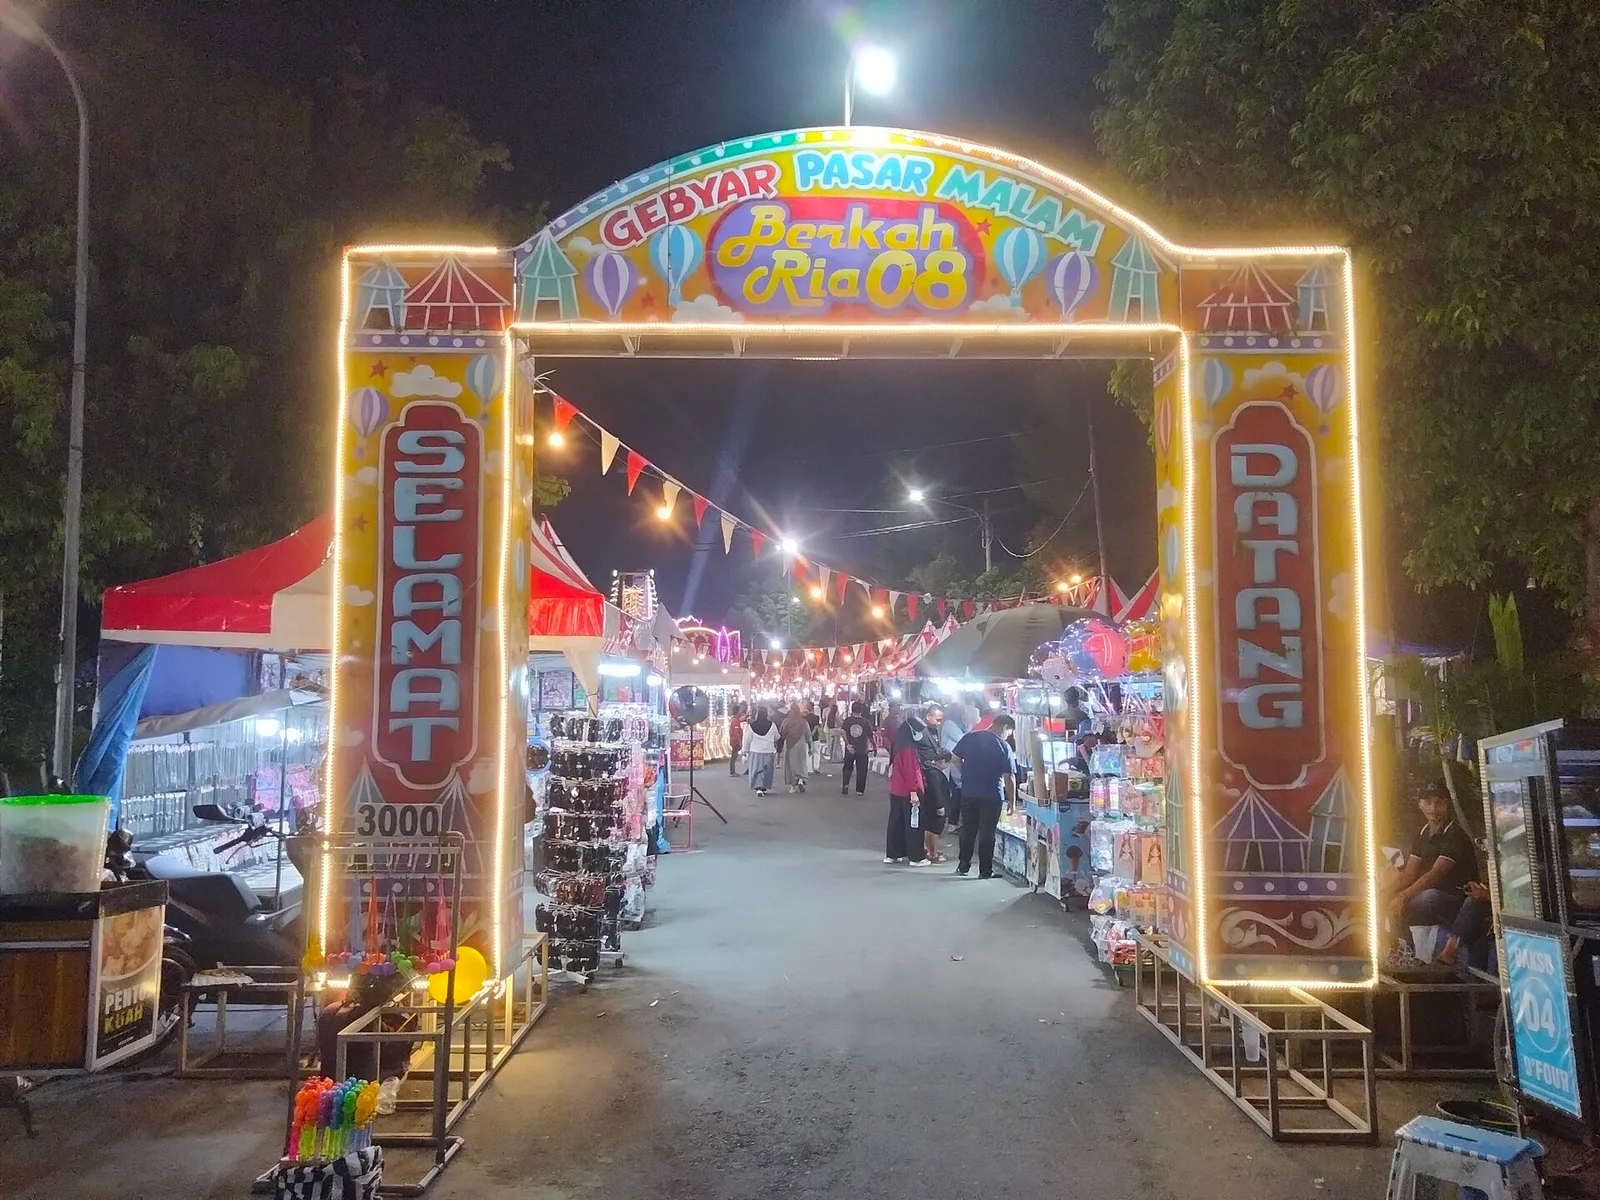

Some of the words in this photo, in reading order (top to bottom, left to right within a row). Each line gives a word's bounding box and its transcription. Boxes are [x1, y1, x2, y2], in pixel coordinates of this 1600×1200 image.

[602, 163, 779, 248] GEBYAR
[795, 152, 934, 195] PASAR
[937, 167, 1101, 254] MALAM
[717, 204, 956, 267] Berkah
[389, 430, 466, 762] SELAMAT
[1230, 444, 1303, 730] DATANG
[357, 804, 440, 837] 3000
[104, 1003, 144, 1034] KUAH
[1523, 1055, 1569, 1093] D'FOUR
